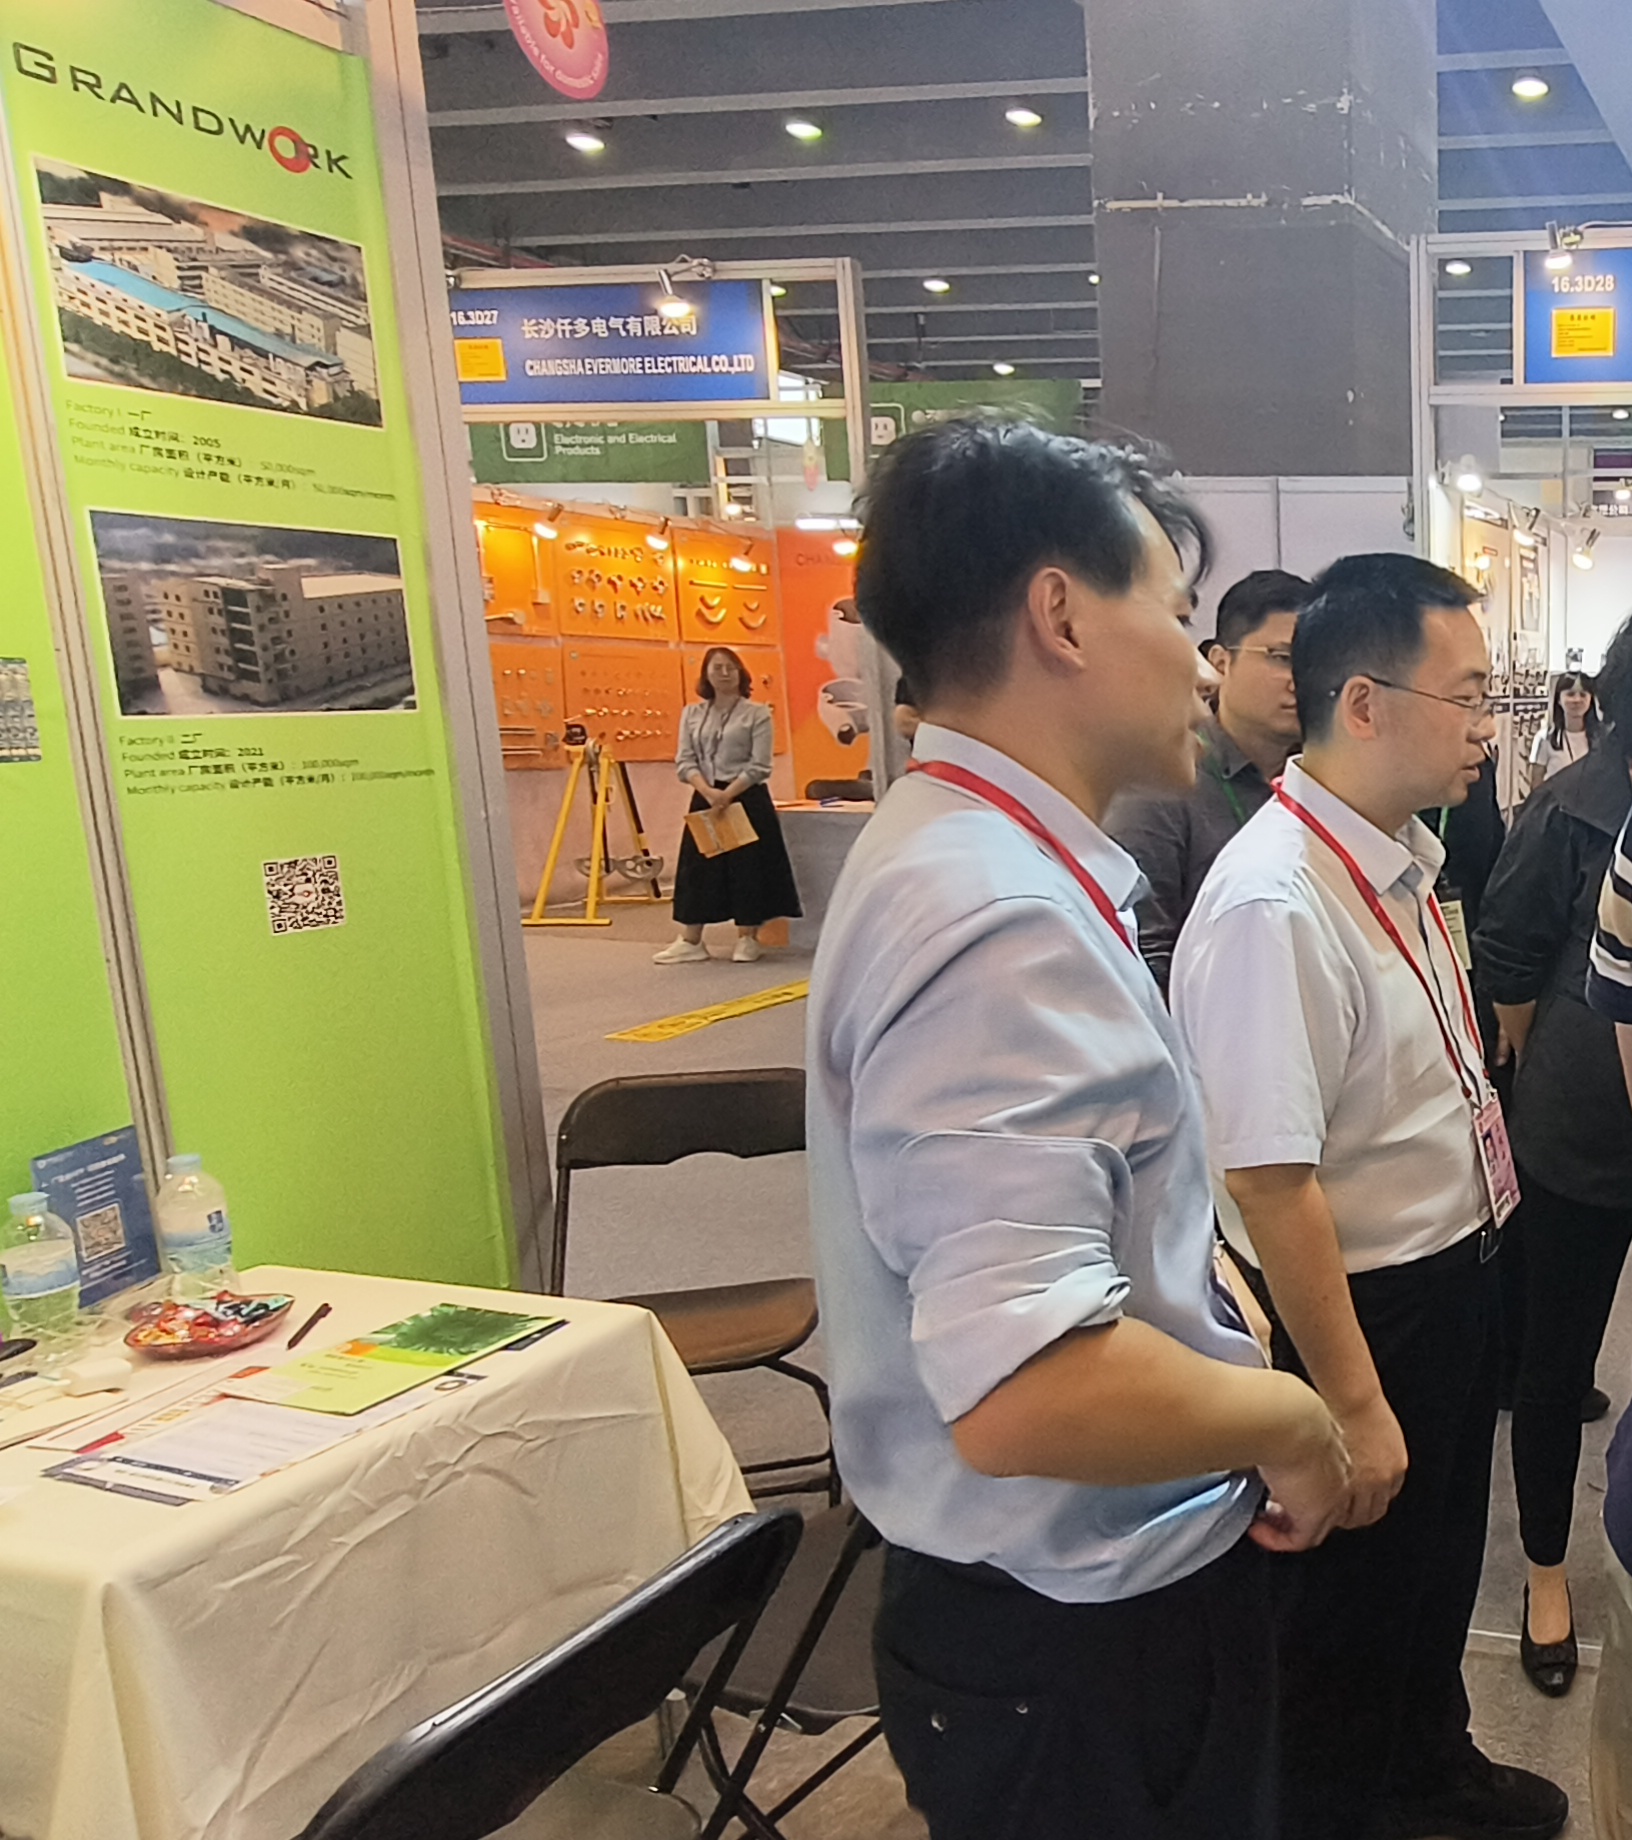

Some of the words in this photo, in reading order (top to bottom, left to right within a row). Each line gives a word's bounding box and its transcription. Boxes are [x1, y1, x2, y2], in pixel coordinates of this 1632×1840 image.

[12, 41, 353, 179] GRANDWORK
[1551, 274, 1614, 293] 16.3D28
[450, 310, 498, 325] 16.3D27
[521, 316, 697, 339] 长沙仟多电气有限公司
[525, 358, 584, 377] CHANGSHA
[585, 357, 643, 375] EVERMORE
[644, 355, 711, 374] ELECTRICAL
[553, 433, 605, 445] Electronic
[607, 433, 626, 444] and
[628, 432, 677, 443] Electrical
[555, 445, 600, 455] Products
